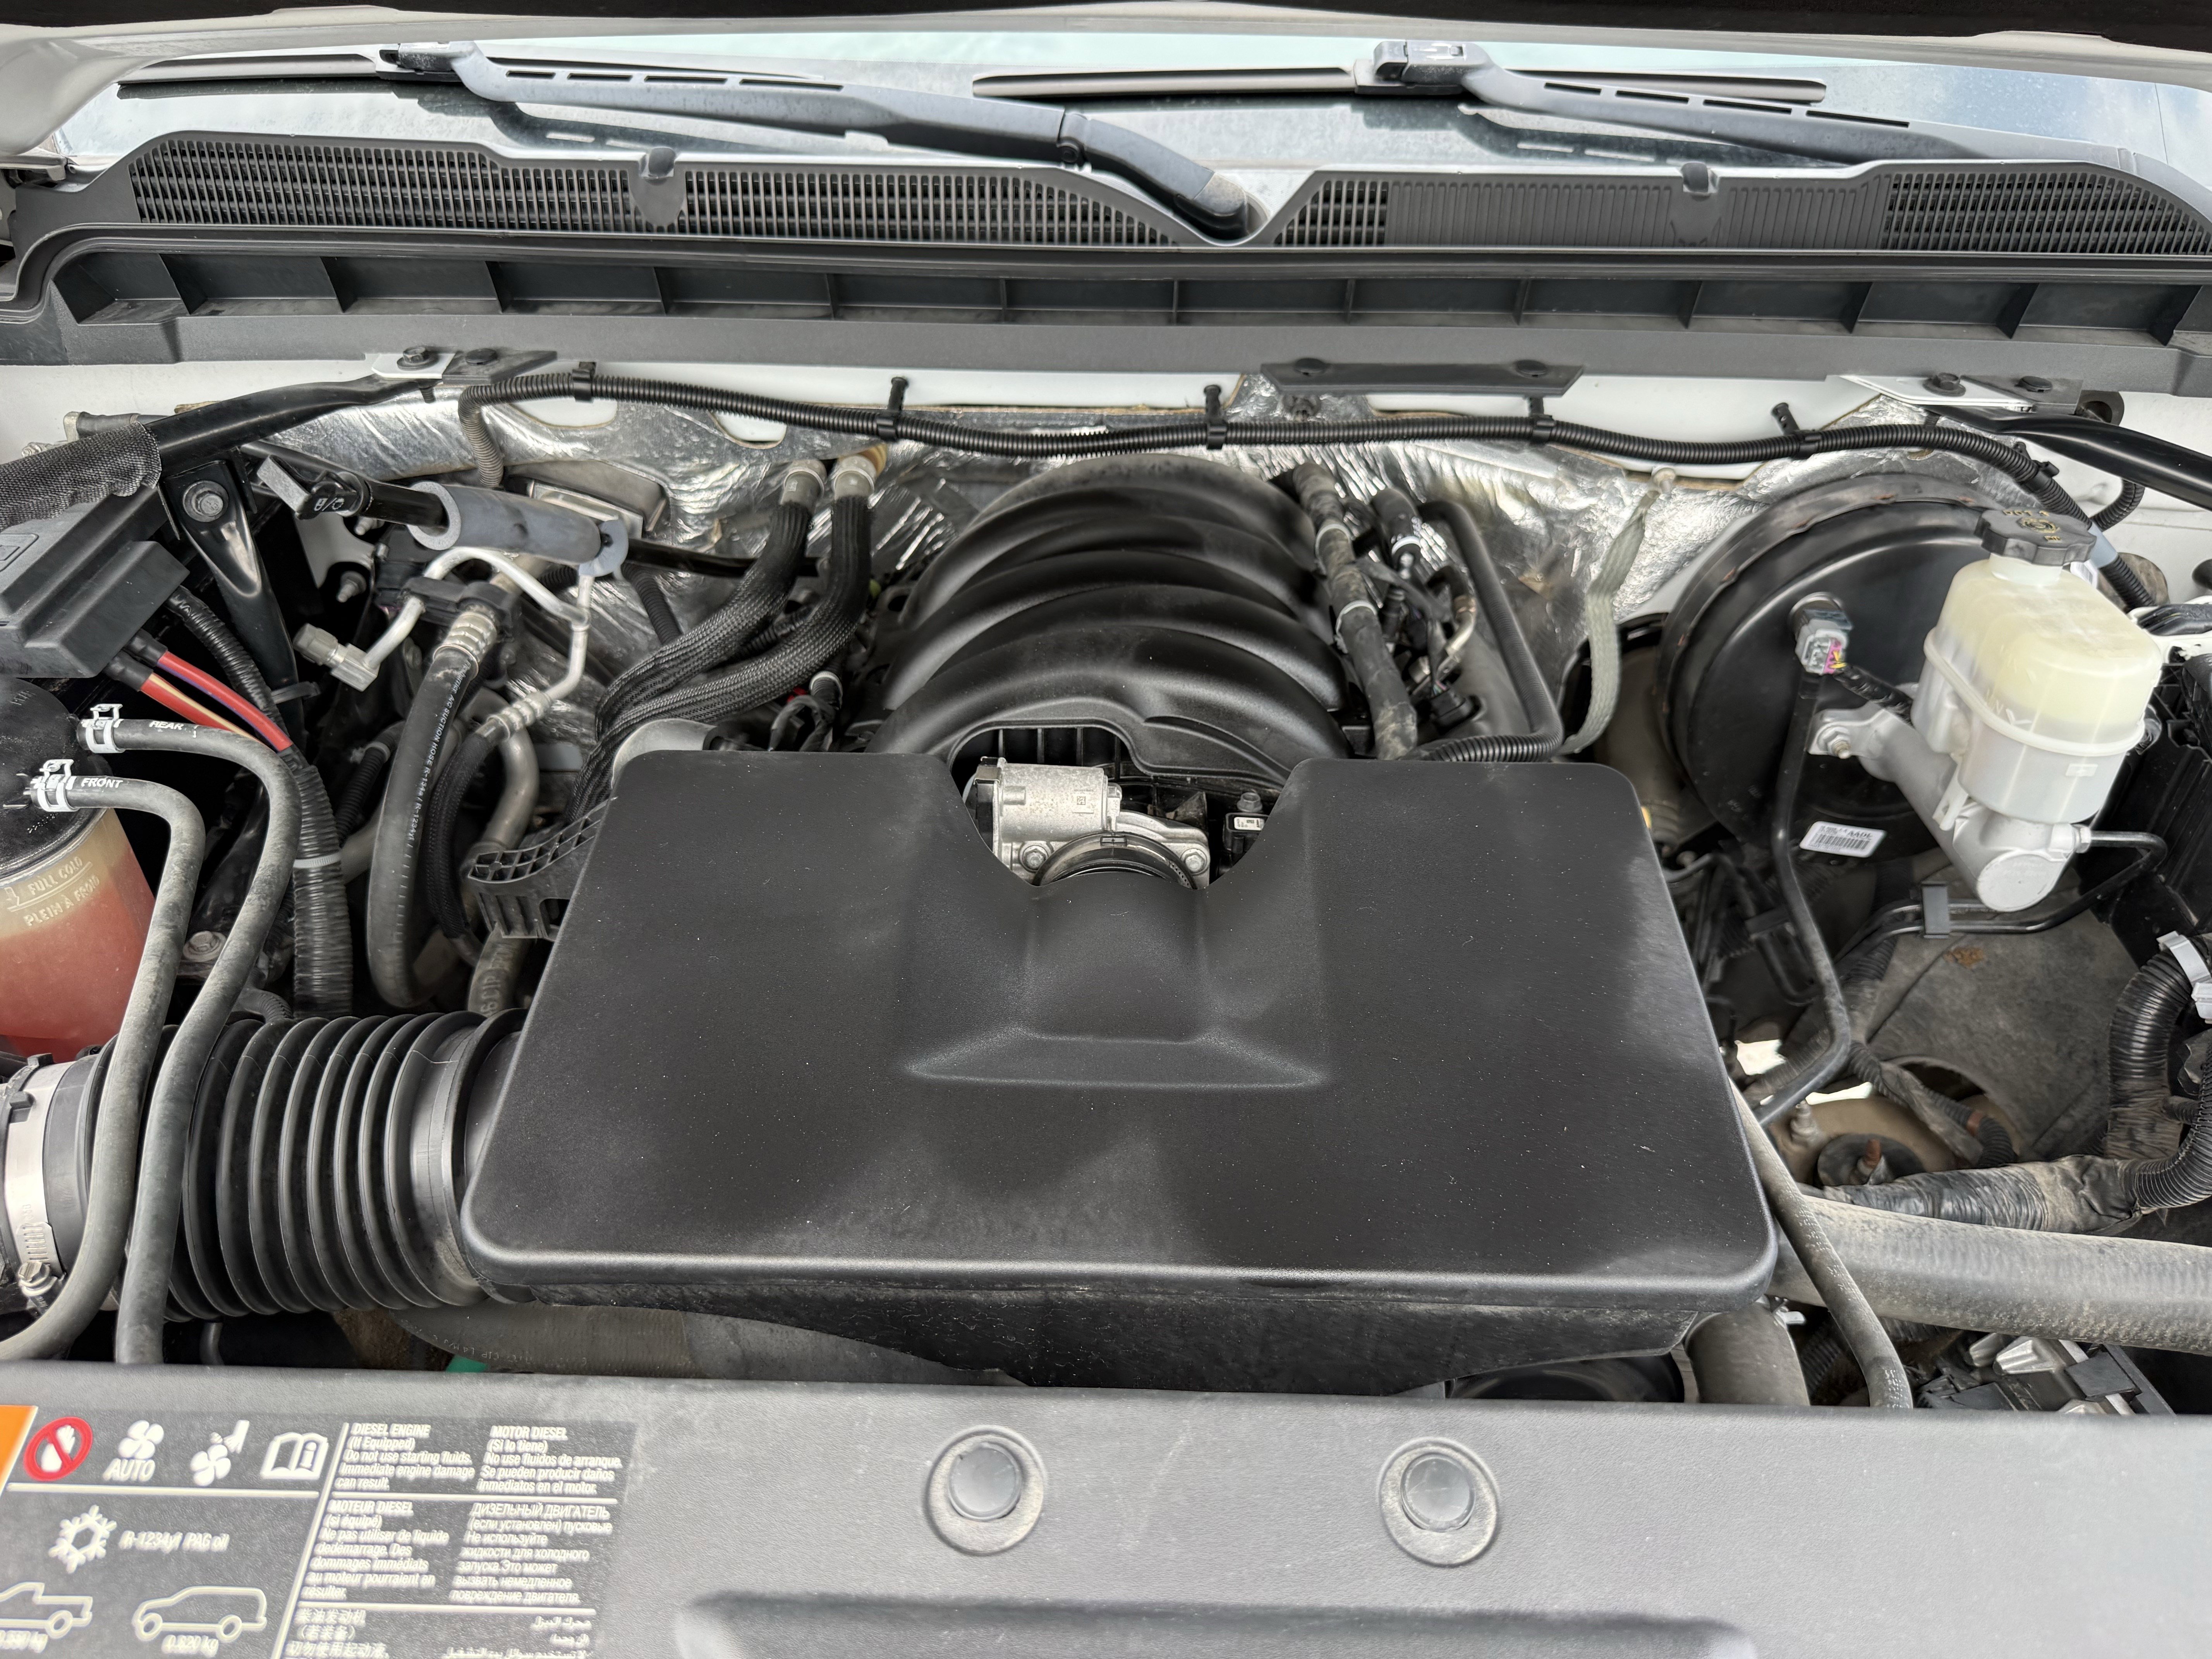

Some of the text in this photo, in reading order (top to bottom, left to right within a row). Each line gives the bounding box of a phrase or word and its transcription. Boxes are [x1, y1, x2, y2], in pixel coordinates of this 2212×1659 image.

[149, 721, 184, 730] REAR
[433, 708, 450, 742] SUCTION
[426, 742, 438, 766] HOSE
[81, 777, 124, 788] FRONT
[27, 856, 82, 895] FULL COLD
[23, 902, 63, 926] PLEIN
[350, 1423, 431, 1437] DIESEL ENGINE
[490, 1425, 568, 1440] MOTOR DIESEL
[362, 1436, 415, 1451] Equipped)
[487, 1439, 548, 1453] (Si lo tiene)
[343, 1449, 472, 1466] Do not use starting fluids.
[484, 1452, 623, 1469] No use fluidos de arranque.
[103, 1458, 155, 1481] AUTO
[339, 1462, 475, 1481] Immediate engine damage
[480, 1465, 615, 1482] Se pueden producir daños
[335, 1477, 389, 1491] can result.
[536, 1482, 551, 1494] en
[551, 1481, 563, 1494] el
[563, 1482, 597, 1495] motor.
[327, 1499, 414, 1516] MOTEUR DIESEL
[469, 1502, 611, 1520] ДИЗЕЛЬНЫЙ ДВИГАТЕЛЬ
[323, 1514, 382, 1530] (si équipé)
[562, 1521, 613, 1535] пусковые
[119, 1530, 230, 1553] R-1234yf PAG oil
[318, 1527, 449, 1546] Ne pas utiliser de liquide
[464, 1531, 548, 1547] Не используйте
[389, 1543, 412, 1558] Des
[459, 1547, 590, 1562] жидкости для холодного
[310, 1556, 429, 1573] dommages immédiats
[522, 1562, 558, 1575] может
[305, 1572, 436, 1588] au moteur pourraient en
[452, 1575, 572, 1590] вызвать немедленное
[448, 1590, 522, 1602] повреждение
[294, 1608, 366, 1626] 柴油发动机
[200, 1635, 219, 1657] kg
